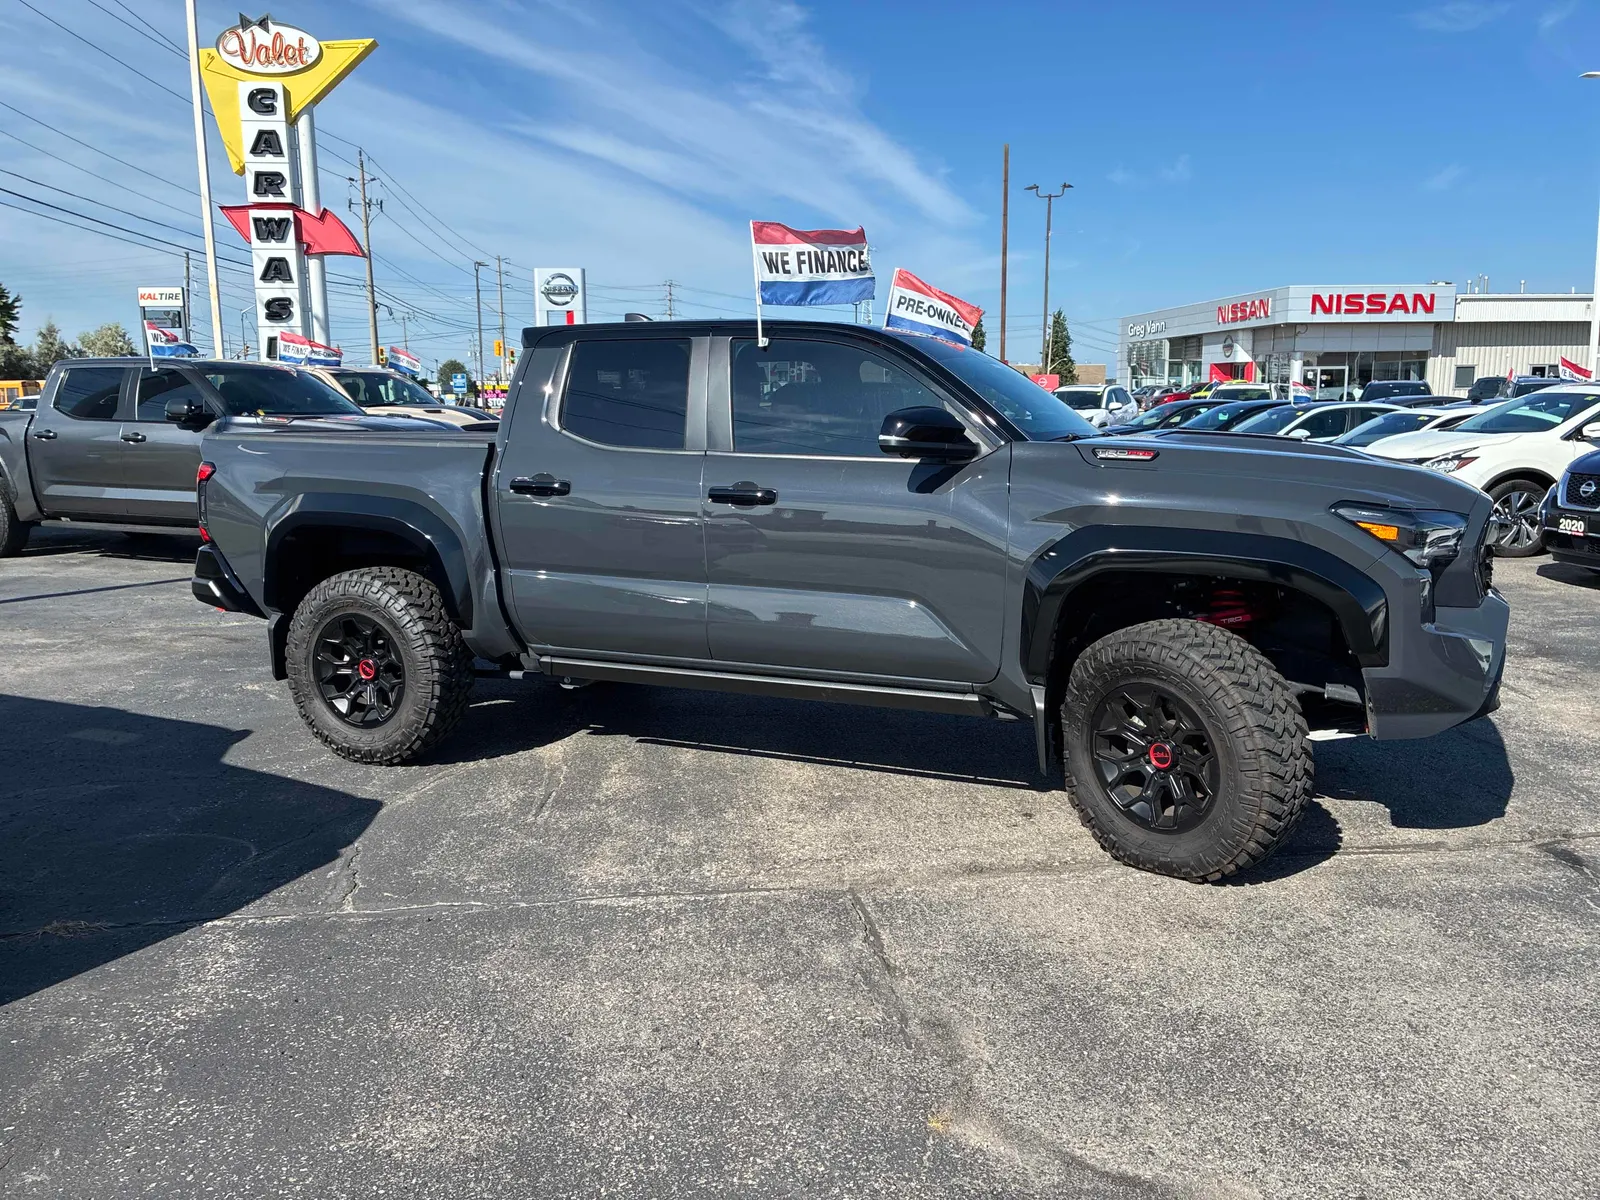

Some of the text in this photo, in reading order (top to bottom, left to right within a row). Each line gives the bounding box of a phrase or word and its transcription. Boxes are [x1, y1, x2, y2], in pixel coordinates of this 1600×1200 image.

[221, 30, 308, 67] Valet
[247, 87, 287, 198] CAR
[762, 250, 869, 274] WE FINANCE
[1217, 298, 1271, 325] NISSAN
[1310, 293, 1436, 315] NISSAN
[1128, 321, 1167, 339] Greg Vann
[1559, 518, 1585, 533] 2020
[1220, 616, 1242, 624] TRD
